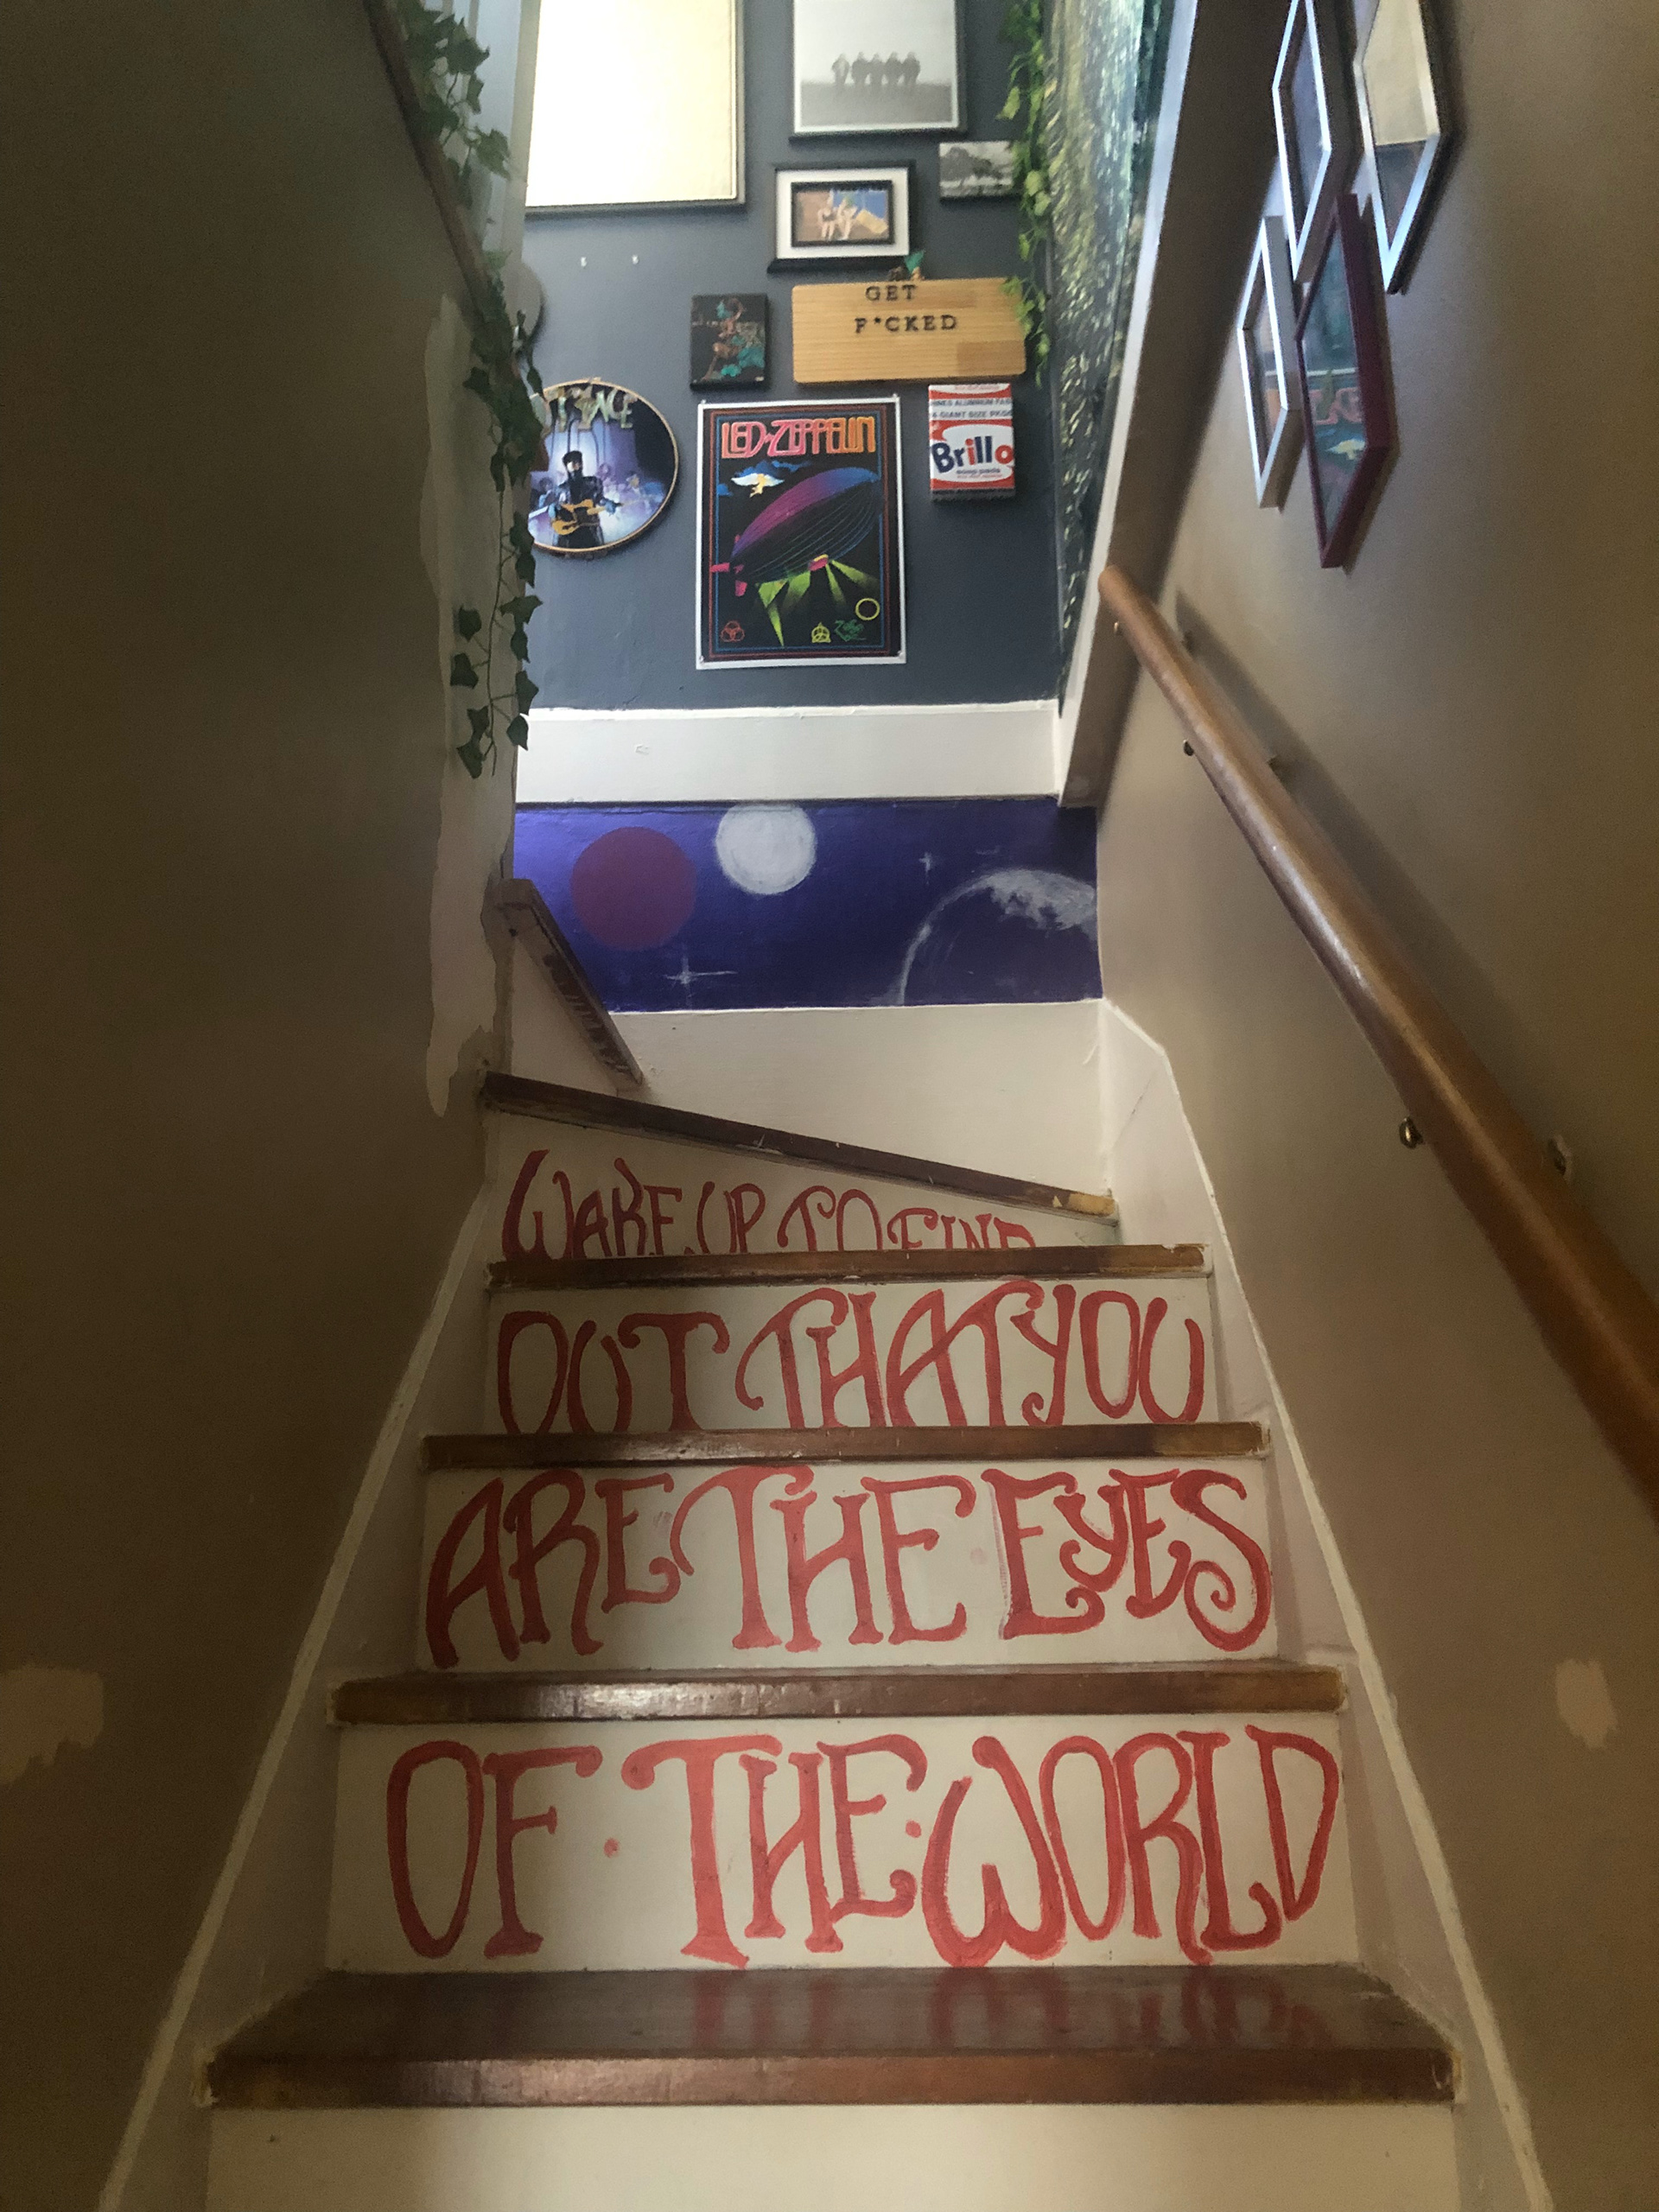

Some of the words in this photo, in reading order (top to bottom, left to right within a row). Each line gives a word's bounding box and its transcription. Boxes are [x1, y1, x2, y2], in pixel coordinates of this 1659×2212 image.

[865, 283, 917, 302] GET
[931, 435, 1014, 474] Brillo
[696, 1180, 766, 1255] UP
[777, 1185, 883, 1252] TO
[496, 1310, 730, 1434] OUT
[734, 1280, 1045, 1428] THAT
[1009, 1283, 1205, 1426] YOU
[426, 1468, 681, 1668] ARE
[671, 1465, 975, 1652] THE
[386, 1739, 602, 1958] OF
[620, 1733, 928, 1968] THE
[920, 1724, 1340, 1968] WORLD
